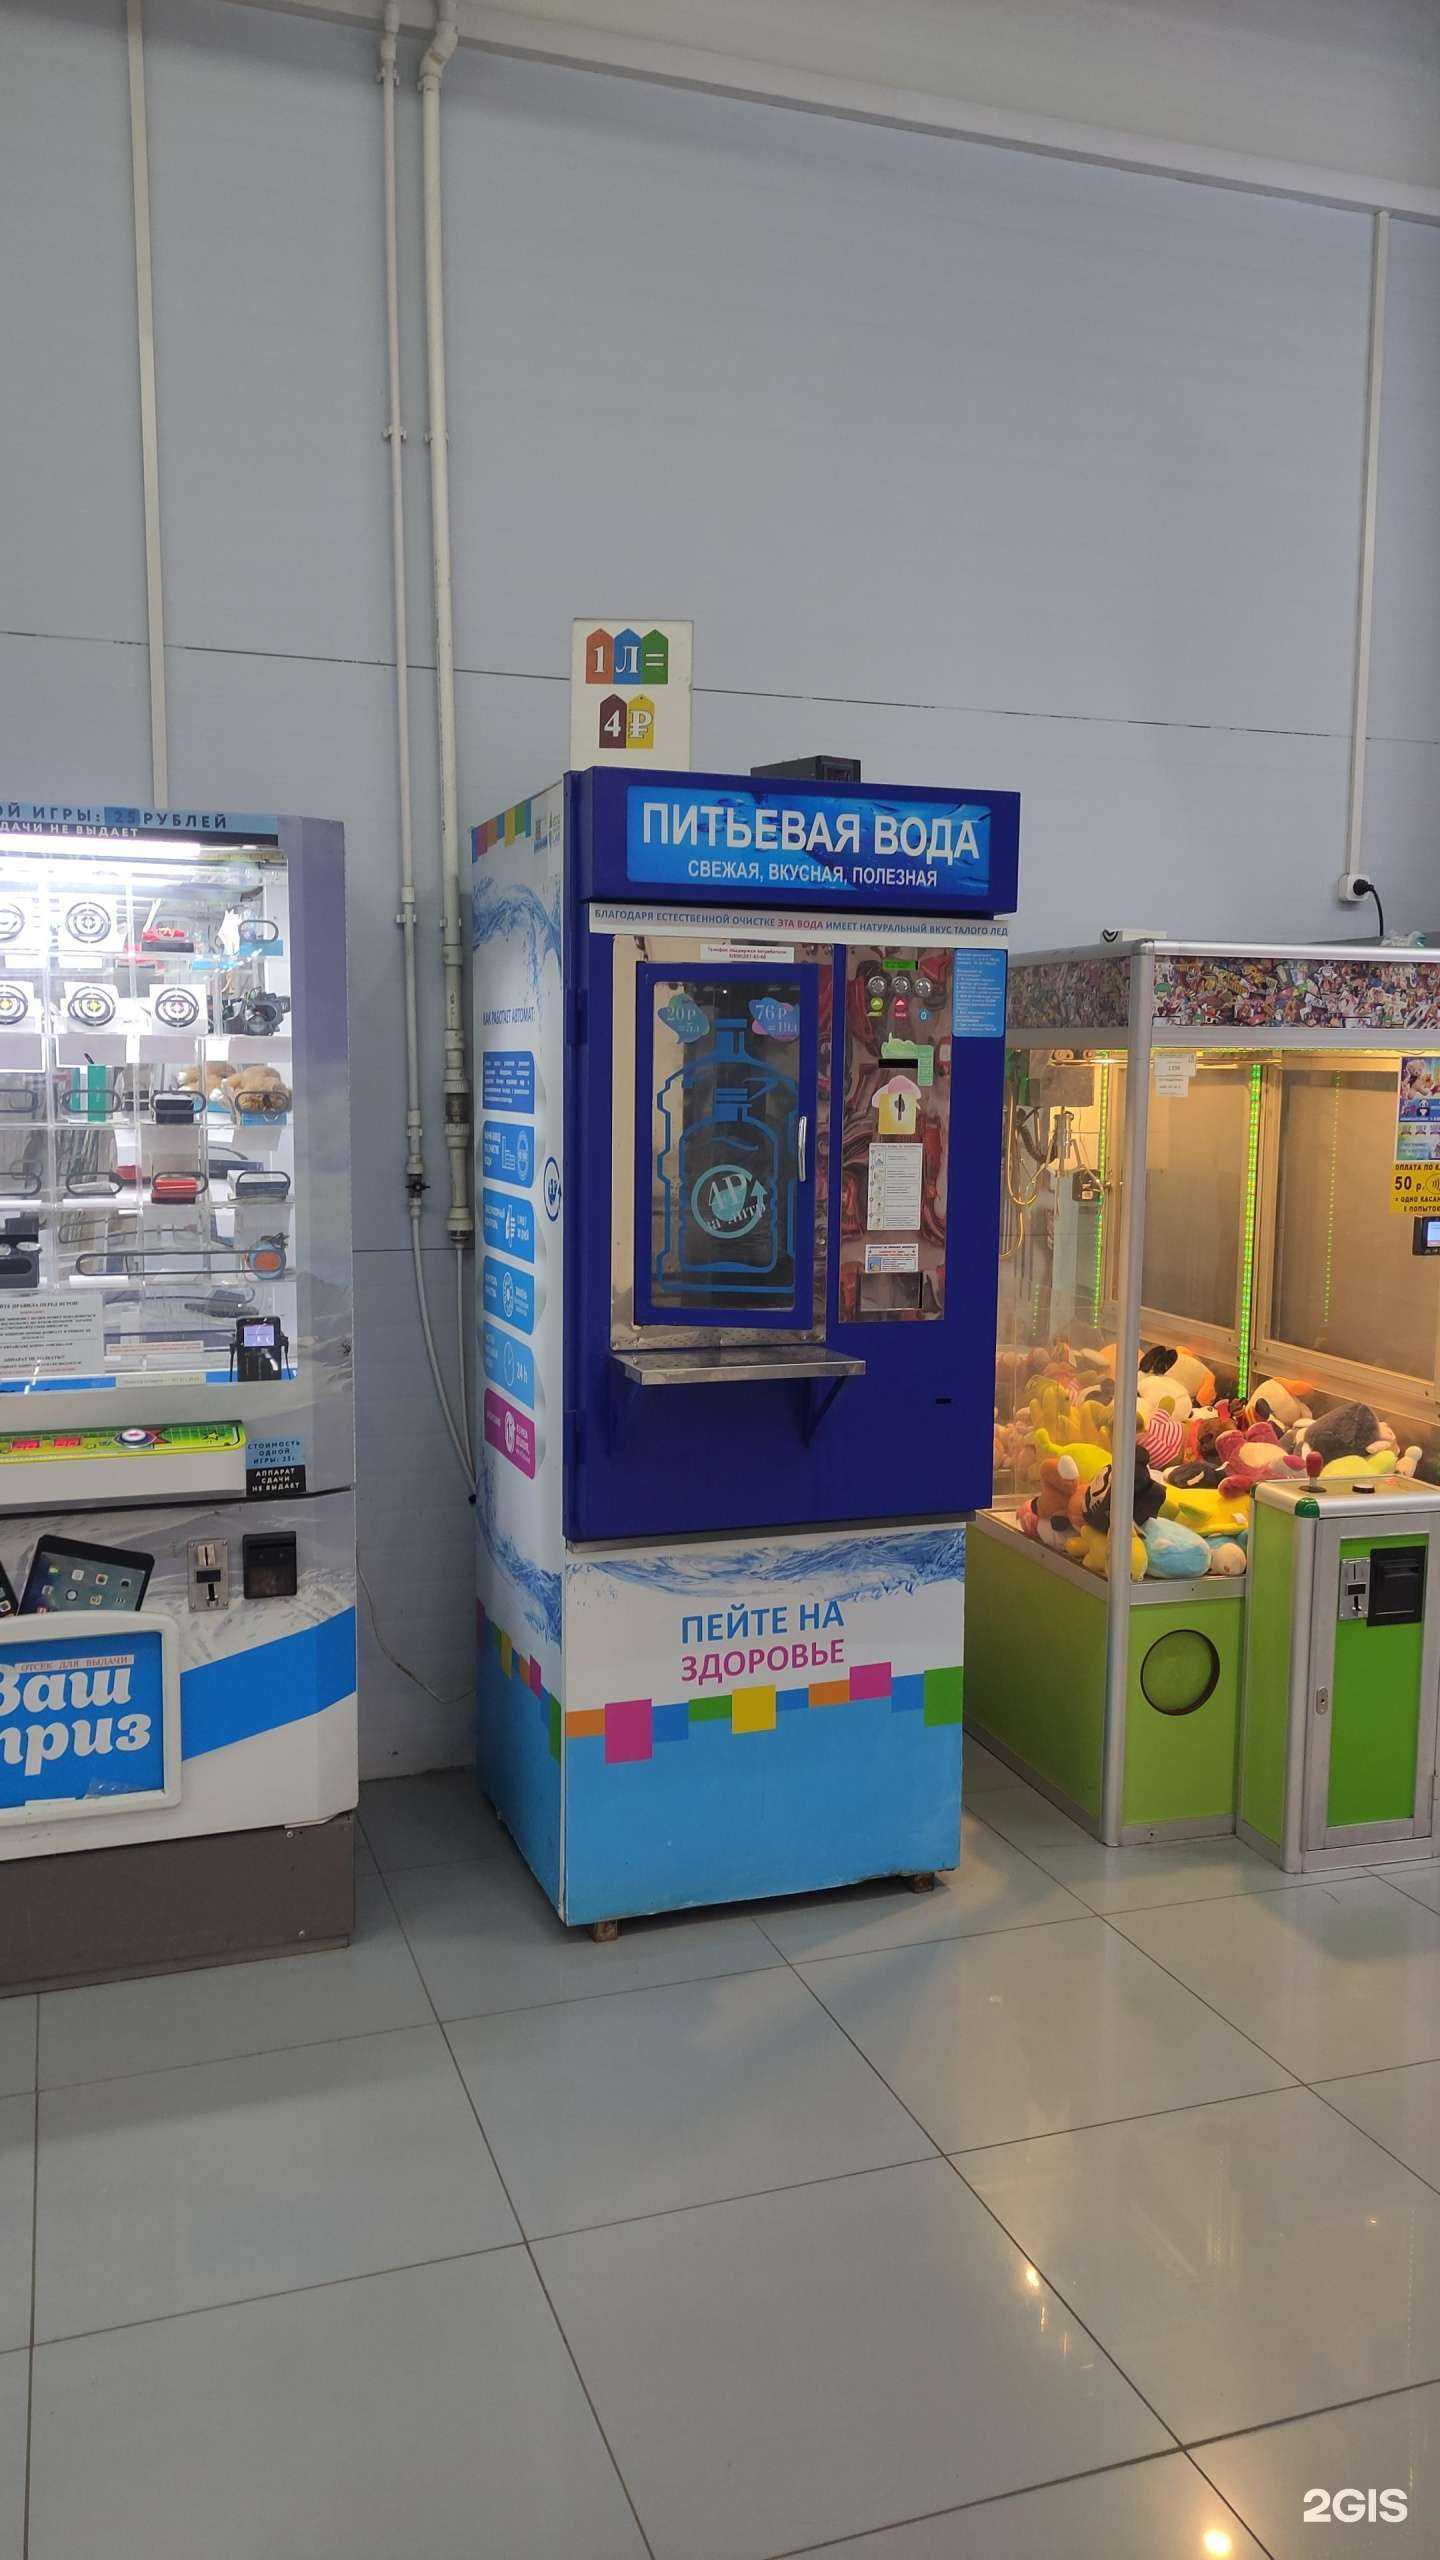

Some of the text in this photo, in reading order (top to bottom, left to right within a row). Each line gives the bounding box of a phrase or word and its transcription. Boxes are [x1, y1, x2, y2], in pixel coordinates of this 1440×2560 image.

[0, 801, 21, 818] Й
[33, 805, 101, 822] ИГРЫ:
[143, 811, 227, 829] РУБЛЕЙ
[50, 823, 69, 834] НЕ
[76, 825, 139, 838] ВЫДАЕТ
[643, 802, 981, 867] ПИТЬЕВАЯ ВОДА
[688, 859, 938, 888] СВЕЖАЯ, ВКУСНАЯ, ПОЛЕЗНАЯ
[594, 909, 653, 922] БЛАГОДАРЯ
[656, 912, 730, 925] ЕСТЕСТВЕННОЙ
[732, 917, 776, 927] ОЧИСТКЕ
[777, 919, 795, 929] ЭТА
[797, 920, 824, 931] ВОДА
[825, 921, 858, 932] ИМЕЕТ
[859, 923, 927, 935] НАТУРАЛЬНЫЙ
[929, 926, 953, 935] ВКУС
[954, 926, 988, 937] ТАЛОГО
[1394, 1175, 1412, 1191] 50
[248, 1440, 301, 1450] СТОИМОСТЬ
[258, 1447, 290, 1457] ОДНОЙ
[256, 1467, 295, 1478] АППАРАТ
[261, 1476, 290, 1484] СДАЧИ
[265, 1482, 300, 1491] ВЫДАЕТ
[682, 1600, 844, 1644] ПЕЙТЕ НА
[20, 1656, 128, 1672] ОТСЕК ДЛЯ ВЫДАЧИ
[681, 1638, 845, 1686] ЗДОРОВЬЕ
